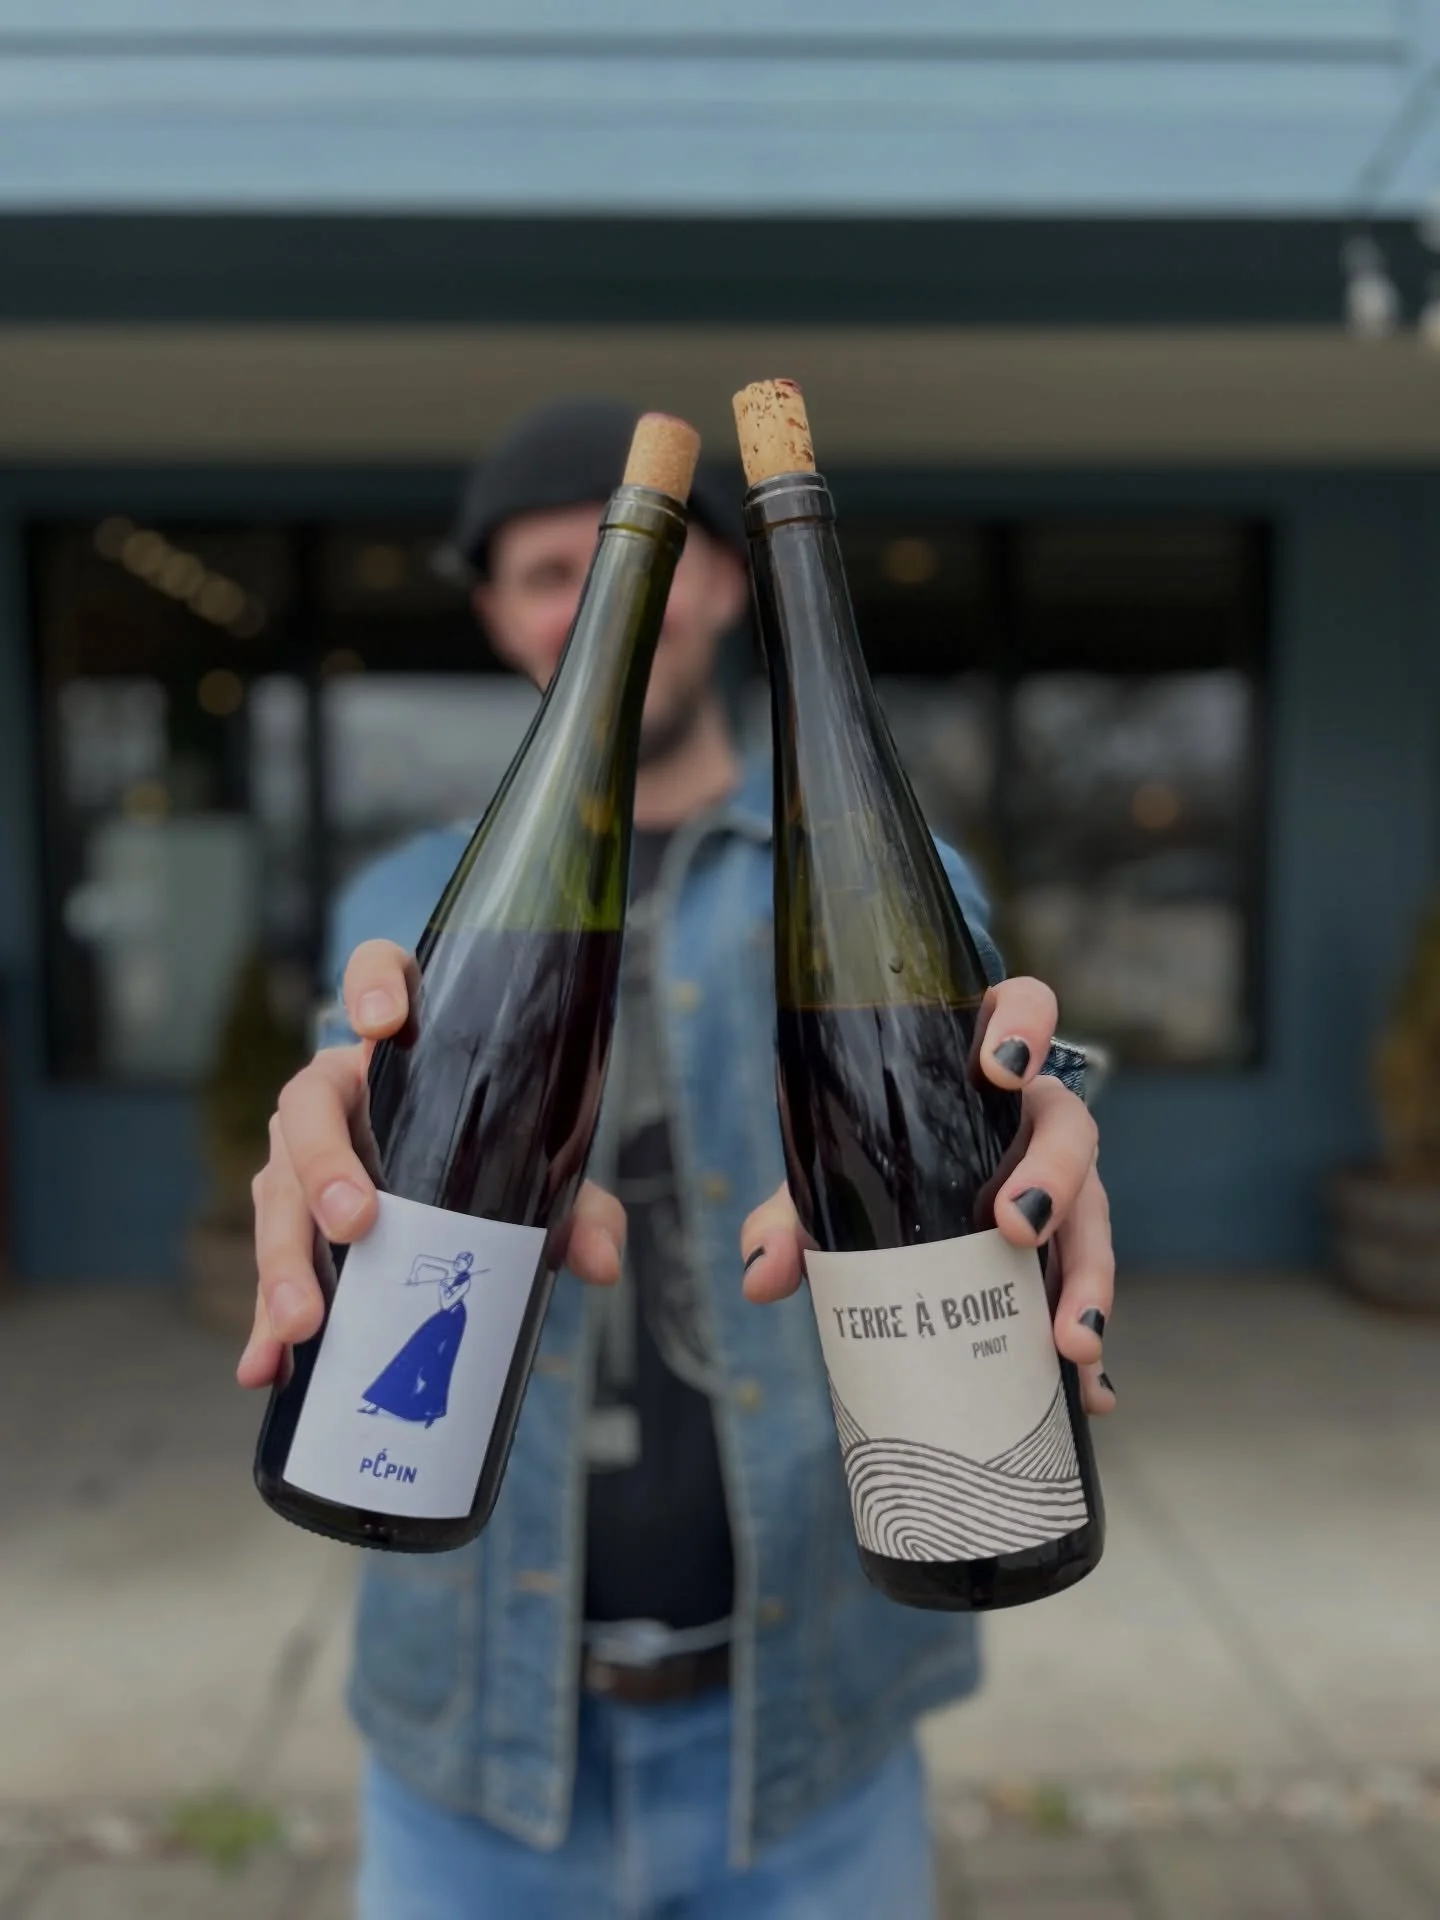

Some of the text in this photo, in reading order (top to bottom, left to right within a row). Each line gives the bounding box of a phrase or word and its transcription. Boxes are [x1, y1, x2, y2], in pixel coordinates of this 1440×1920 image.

[833, 1282, 1019, 1339] TERRE À BOIRE
[972, 1335, 1008, 1359] PINOT
